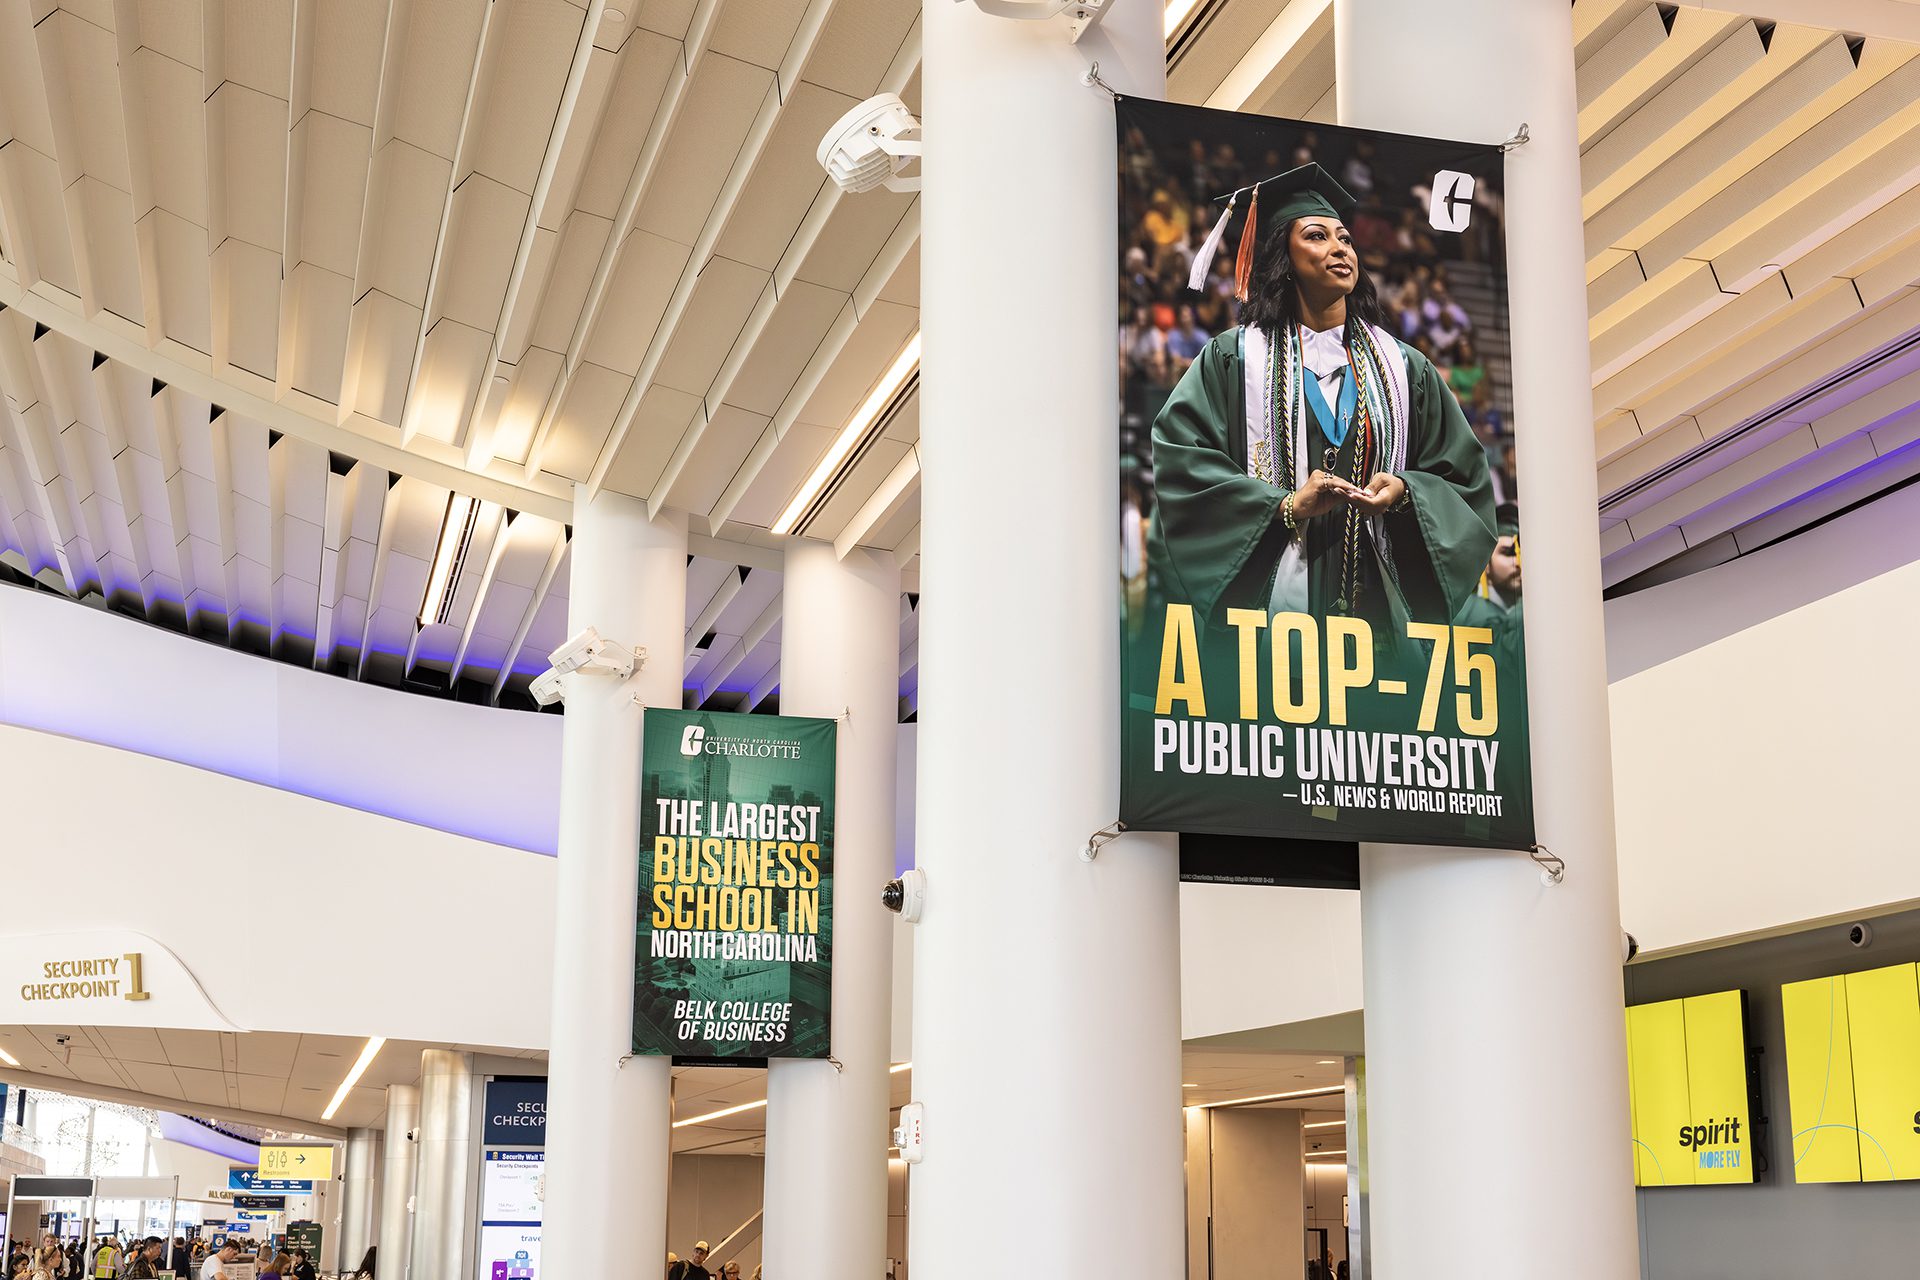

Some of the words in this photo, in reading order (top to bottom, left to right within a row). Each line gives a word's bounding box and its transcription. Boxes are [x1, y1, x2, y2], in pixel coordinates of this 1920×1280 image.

[1154, 602, 1207, 718] A
[1226, 607, 1499, 737] TOP-75
[704, 741, 801, 759] CHARLOTTE
[1153, 718, 1285, 778] PUBLIC
[1295, 727, 1500, 792] UNIVERSITY
[1300, 783, 1331, 807] U.S.
[1334, 785, 1377, 810] NEWS
[1380, 790, 1391, 810] &
[1393, 789, 1446, 814] WORLD
[1449, 792, 1503, 817] REPORT
[656, 798, 703, 837] THE
[710, 801, 821, 842] LARGEST
[653, 836, 820, 889] BUSINESS
[652, 884, 779, 933] SCHOOL
[787, 889, 819, 934] IN
[651, 929, 717, 959] NORTH
[722, 933, 818, 962] CAROLINA
[43, 958, 119, 979] SECURITY
[123, 952, 151, 1001] 1
[20, 979, 121, 1001] CHECKPOINT
[673, 1000, 717, 1020] BELK
[720, 1000, 793, 1022] COLLEGE
[677, 1020, 701, 1040] OF
[703, 1021, 787, 1042] BUSINESS
[516, 1102, 547, 1113] SECU
[493, 1115, 546, 1127] CHECKP
[1678, 1117, 1740, 1153] spirit
[502, 1153, 525, 1161] Security
[1699, 1151, 1725, 1169] MORE
[1726, 1150, 1741, 1168] FLY
[208, 1190, 219, 1199] ALL
